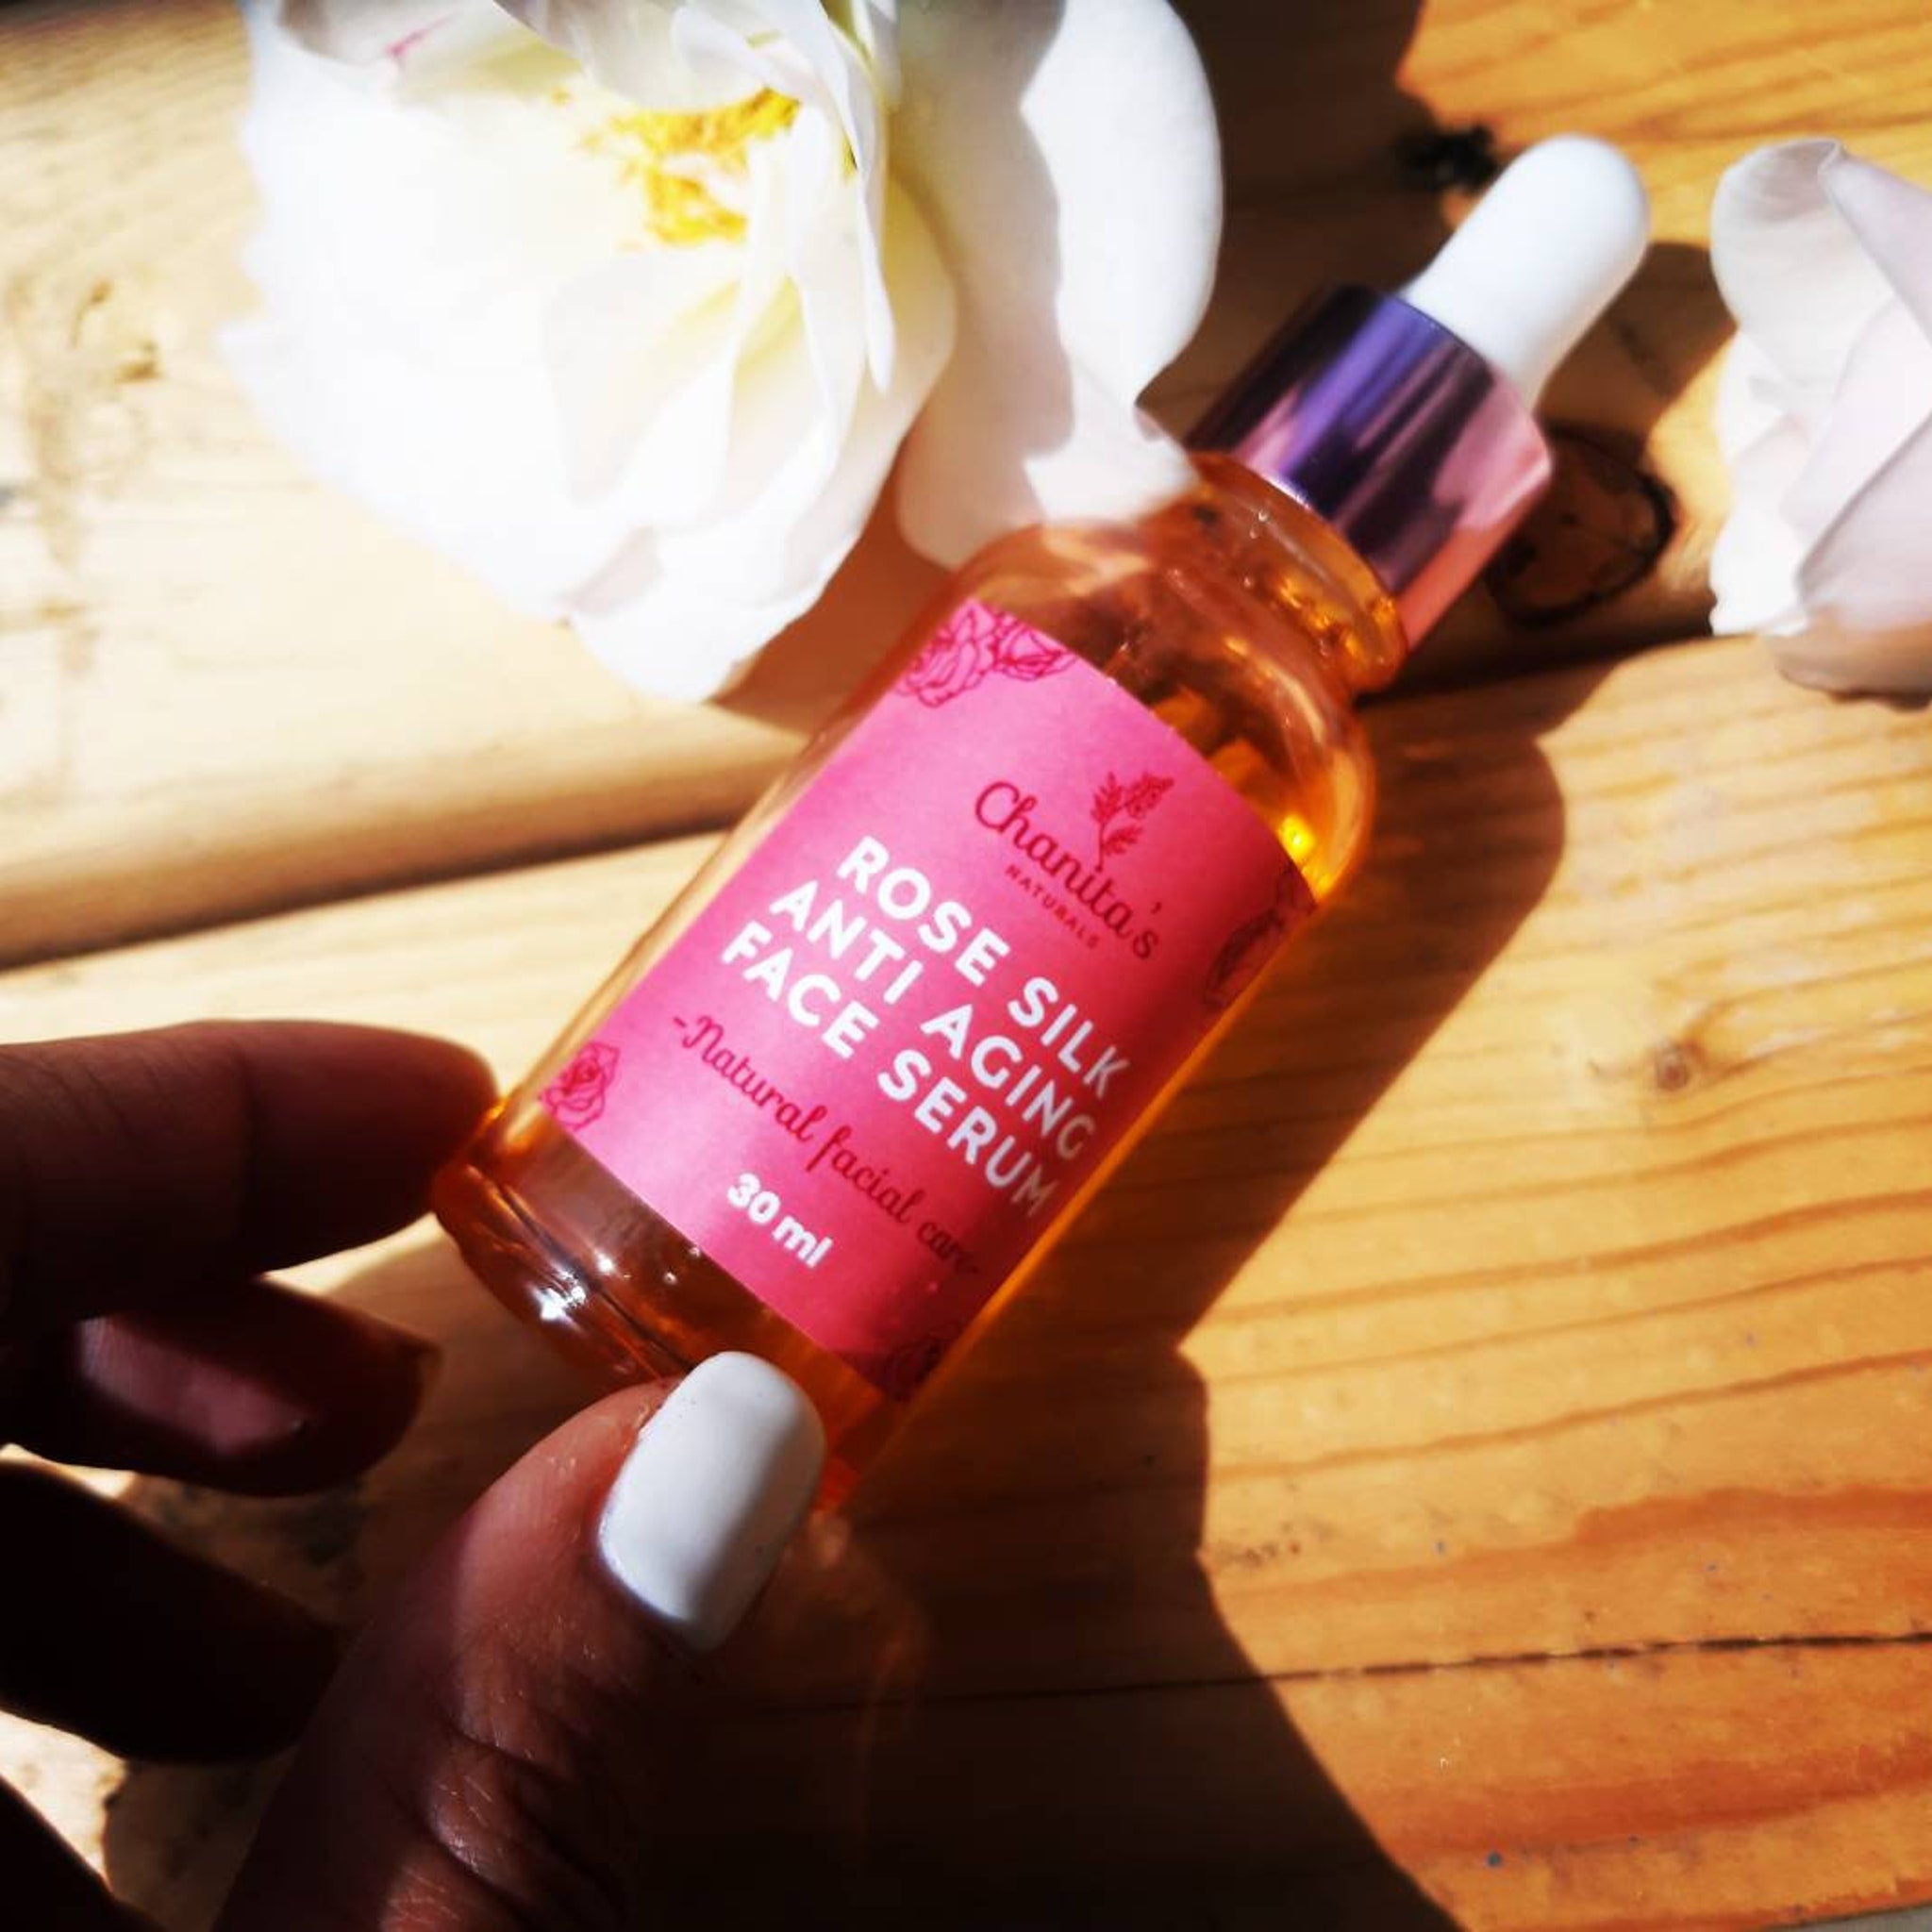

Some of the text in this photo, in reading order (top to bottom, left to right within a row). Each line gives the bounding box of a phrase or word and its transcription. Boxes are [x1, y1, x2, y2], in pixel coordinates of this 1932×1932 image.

[974, 780, 1159, 960] Chanita's
[1005, 866, 1099, 949] NATURALS
[770, 880, 1095, 1160] ANTI AGING
[838, 836, 1130, 1099] ROSE SILK
[721, 922, 1060, 1215] FACE SERUM
[726, 1173, 834, 1268] 30 ml
[806, 1125, 925, 1226] facial
